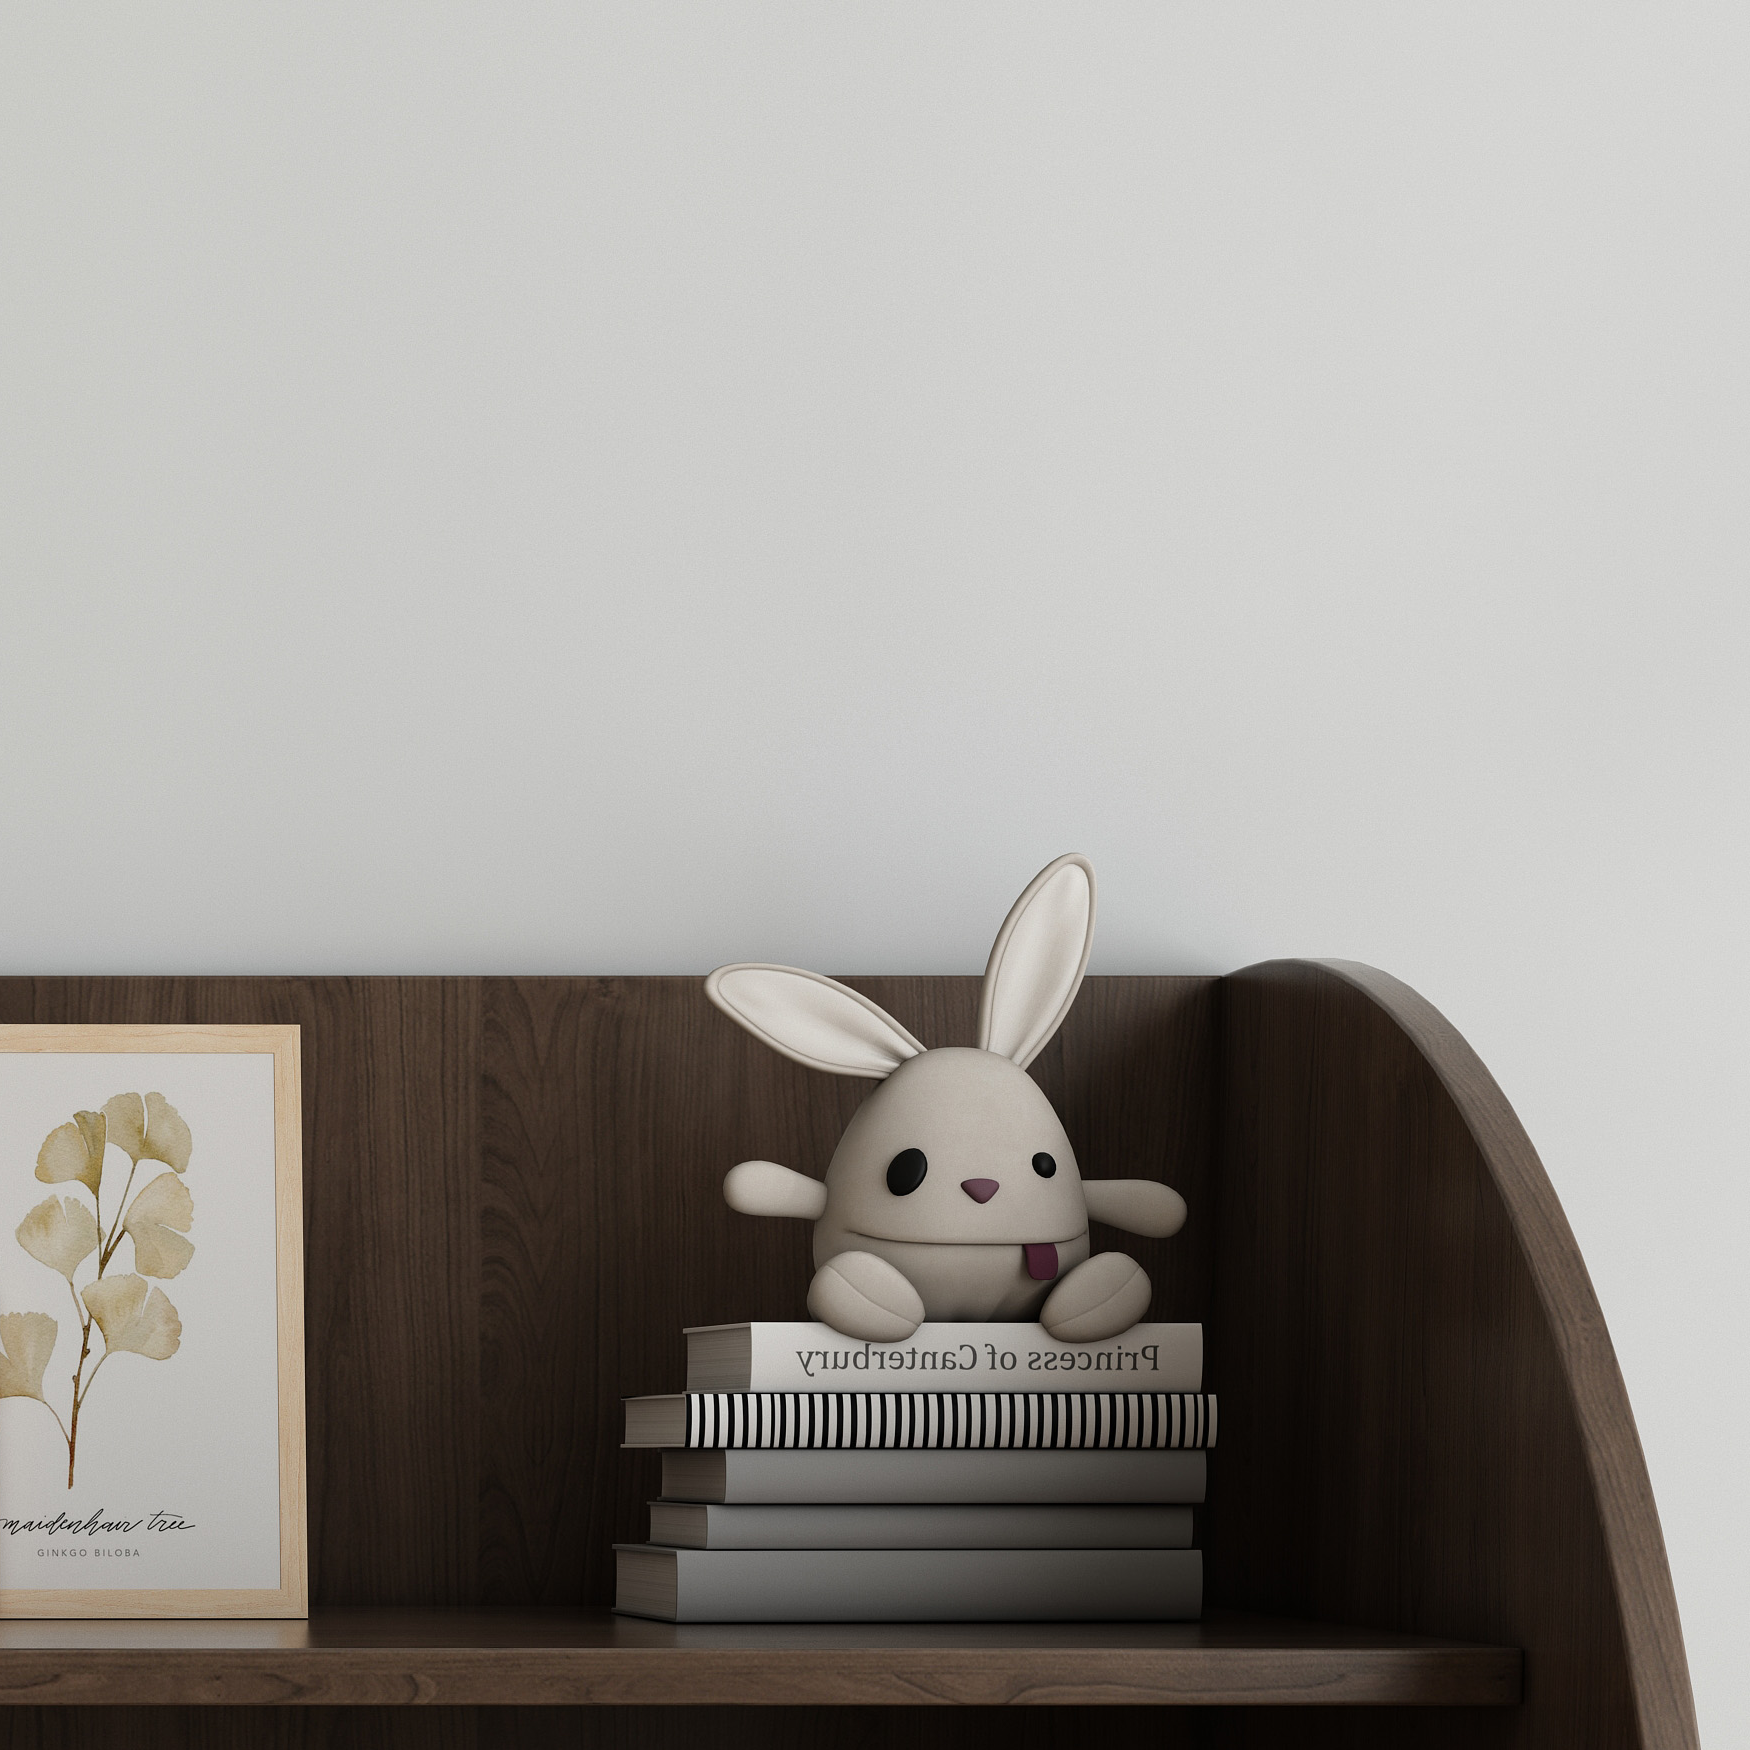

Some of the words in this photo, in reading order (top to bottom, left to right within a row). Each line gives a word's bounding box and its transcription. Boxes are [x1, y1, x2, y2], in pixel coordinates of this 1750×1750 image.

[0, 1508, 143, 1536] maidenhair
[146, 1510, 196, 1531] tree
[37, 1548, 88, 1558] GINKGO
[94, 1548, 140, 1558] BILOBA
